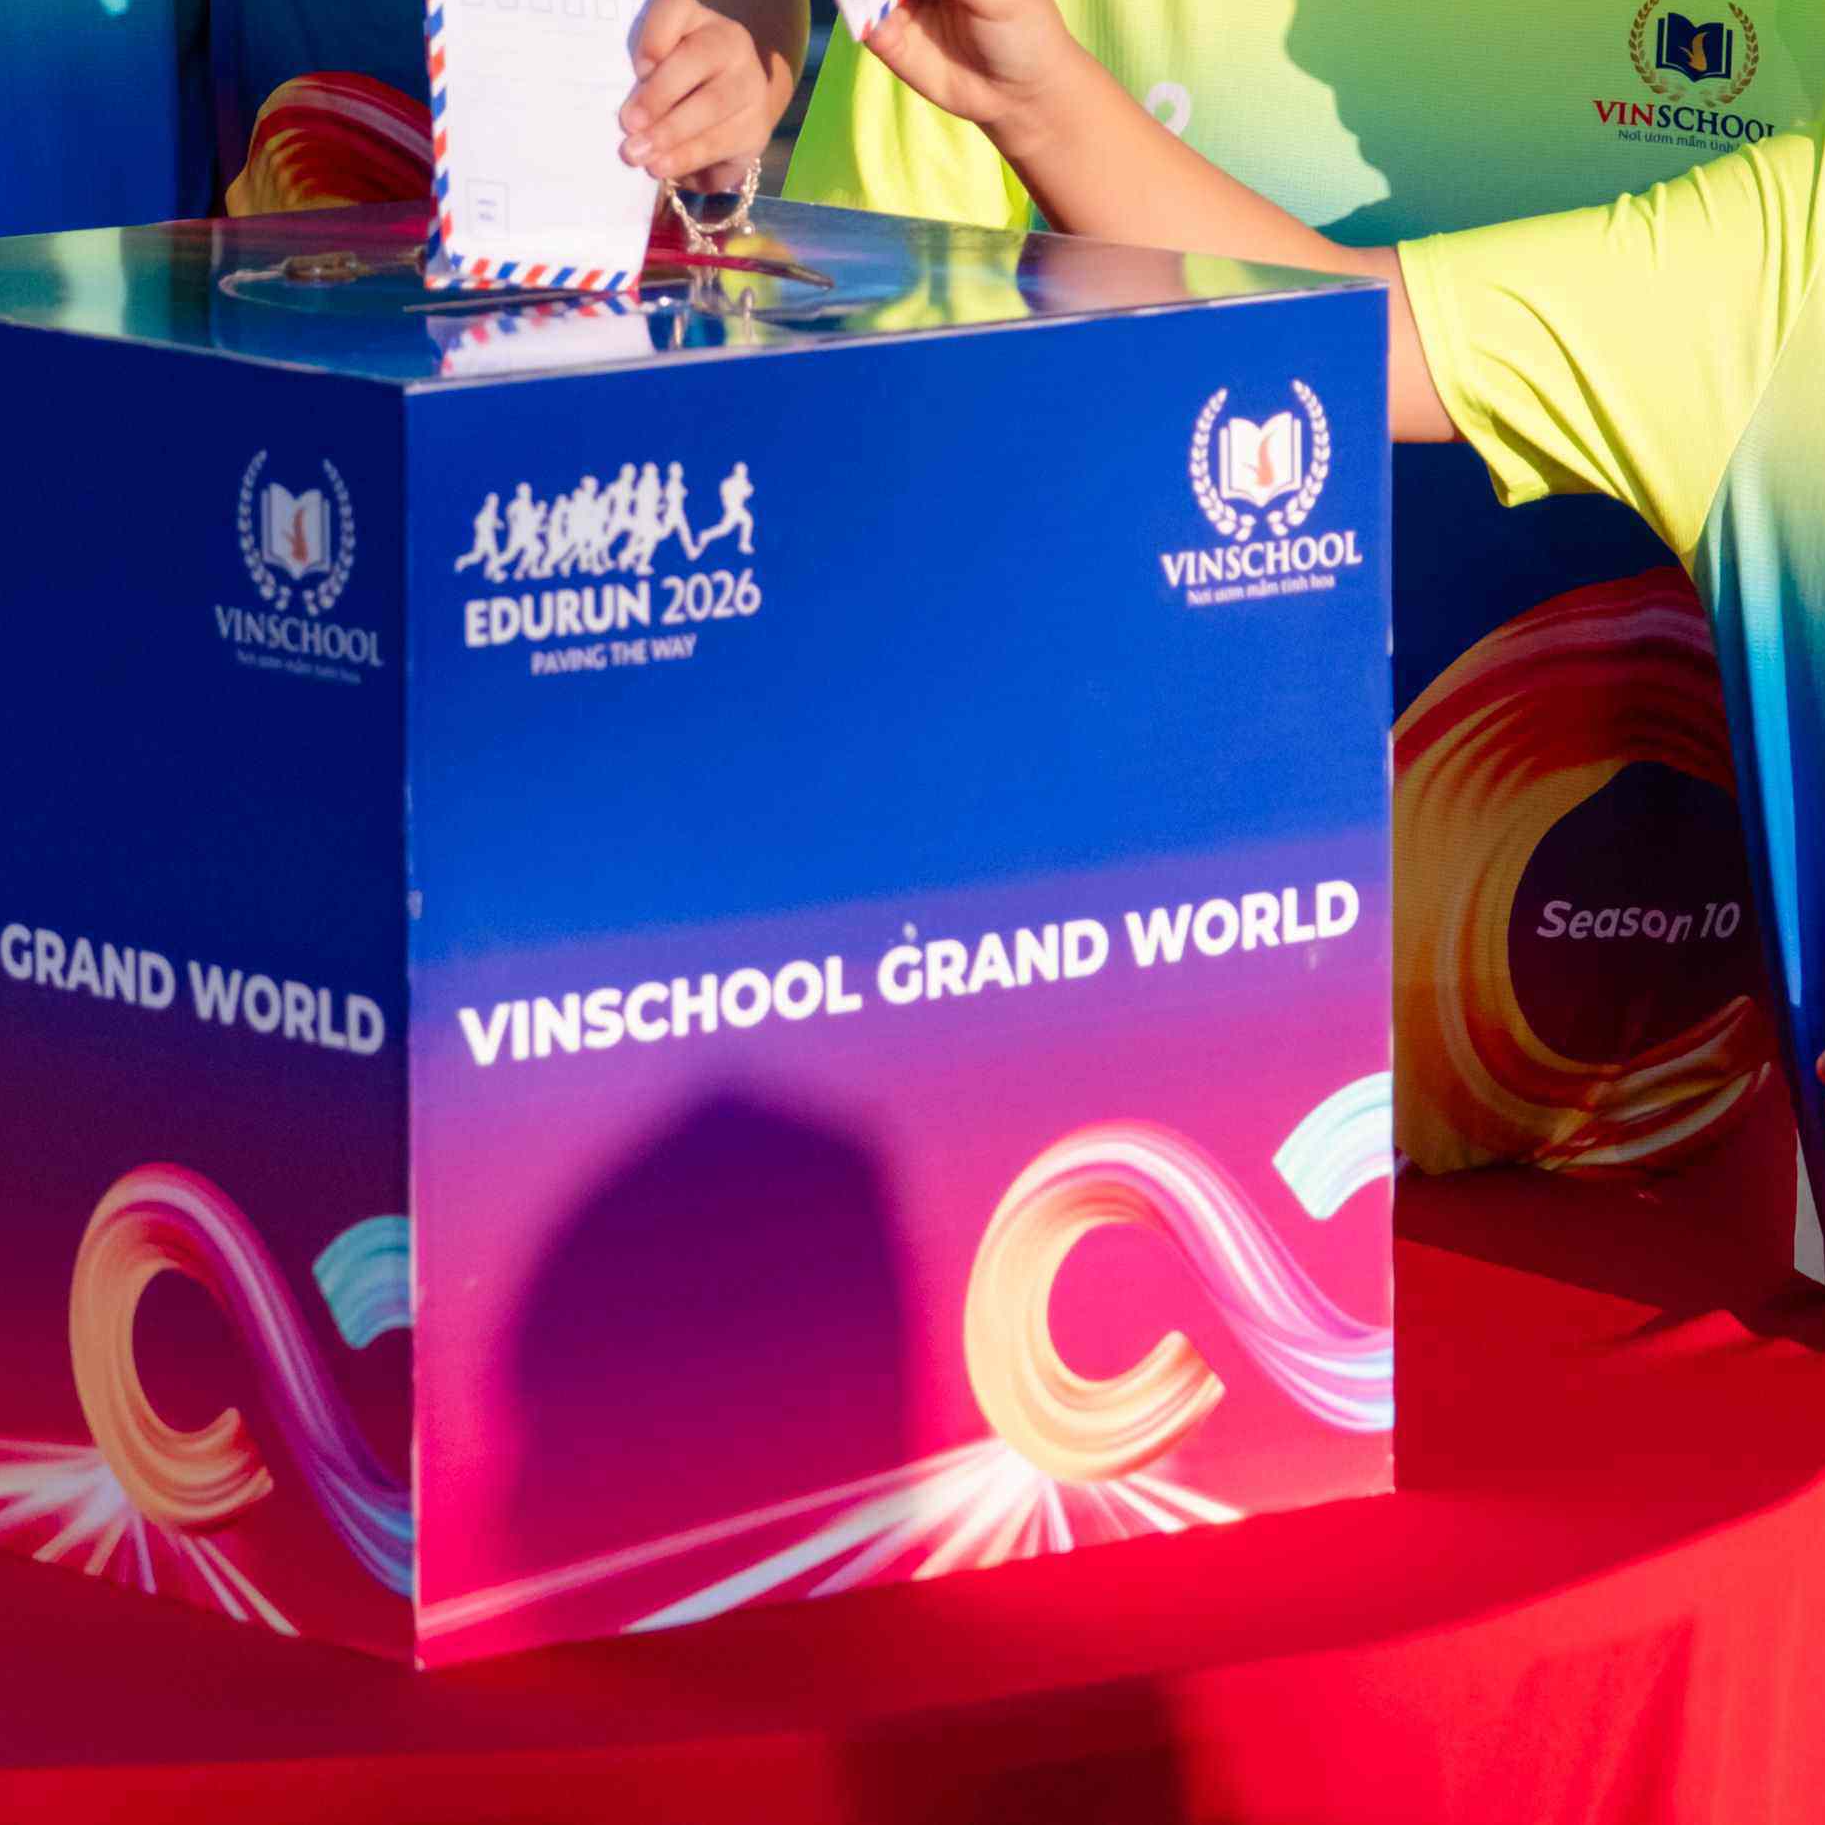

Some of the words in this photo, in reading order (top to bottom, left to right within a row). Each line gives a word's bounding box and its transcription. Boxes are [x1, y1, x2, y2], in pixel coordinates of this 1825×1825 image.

[1160, 530, 1363, 587] VINSCHOOL
[214, 604, 386, 667] VINSCHOOL
[465, 580, 651, 648] EDURUN
[660, 568, 762, 625] 2026
[531, 643, 608, 676] PAVING
[611, 638, 648, 666] THE
[650, 633, 697, 661] WAY
[1536, 900, 1693, 943] Season
[1700, 901, 1741, 939] 10
[0, 922, 175, 1010] GRAND
[188, 960, 386, 1055] WORLD
[458, 955, 862, 1066] VINSCHOOL
[876, 918, 1109, 1006] GRAND
[1123, 879, 1361, 967] WORLD
